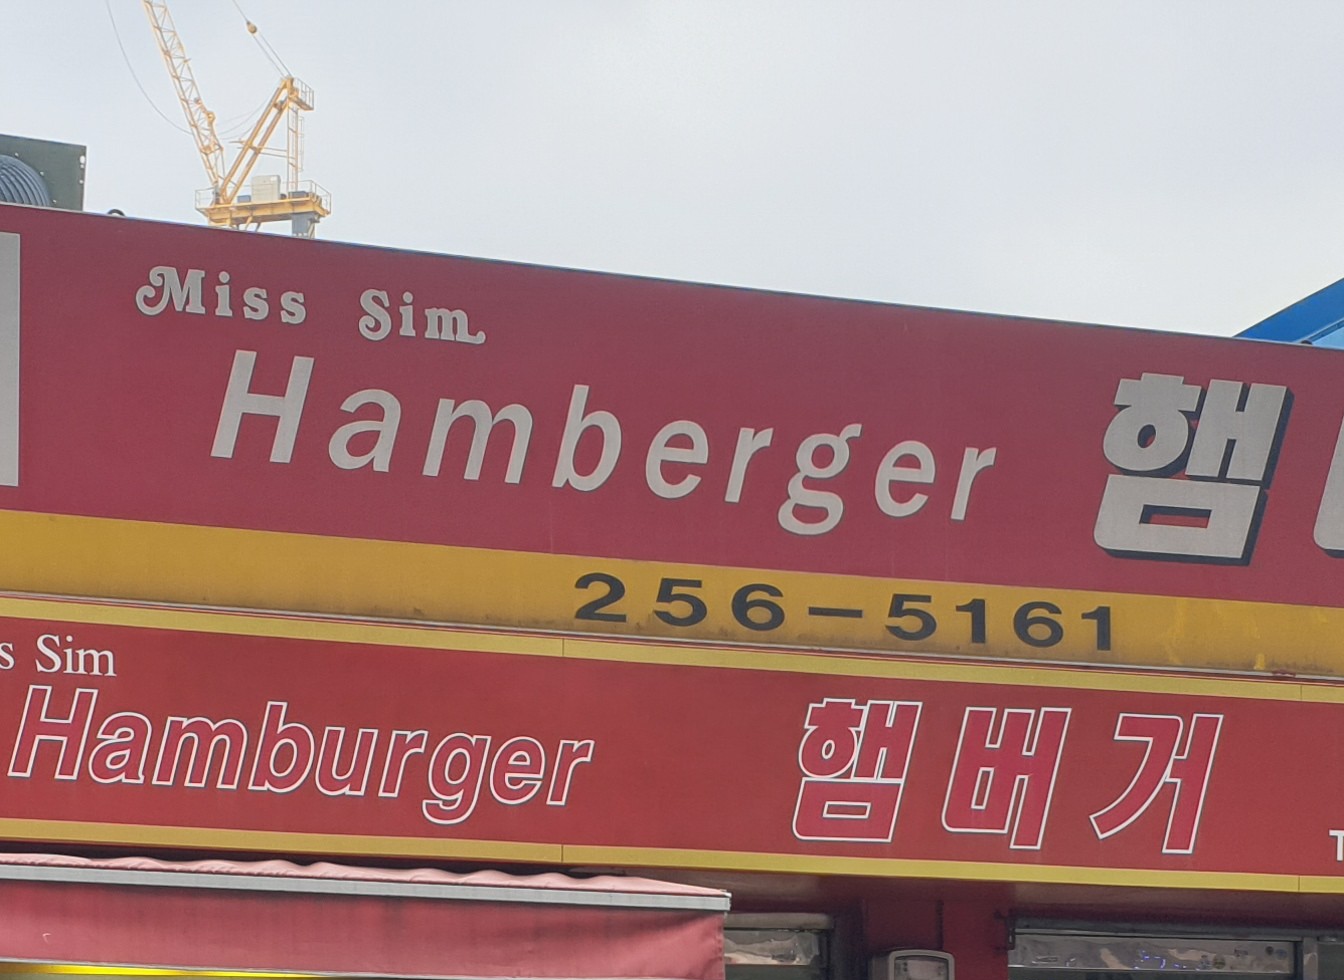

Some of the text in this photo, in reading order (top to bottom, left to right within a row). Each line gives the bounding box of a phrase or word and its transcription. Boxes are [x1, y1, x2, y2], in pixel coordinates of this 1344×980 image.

[134, 265, 487, 346] Miss Sim
[210, 348, 997, 536] Hamberger
[34, 634, 117, 677] Sim
[572, 571, 1113, 651] 256-5161
[8, 683, 595, 826] Hamburger
[790, 697, 1224, 855] 햄버거
